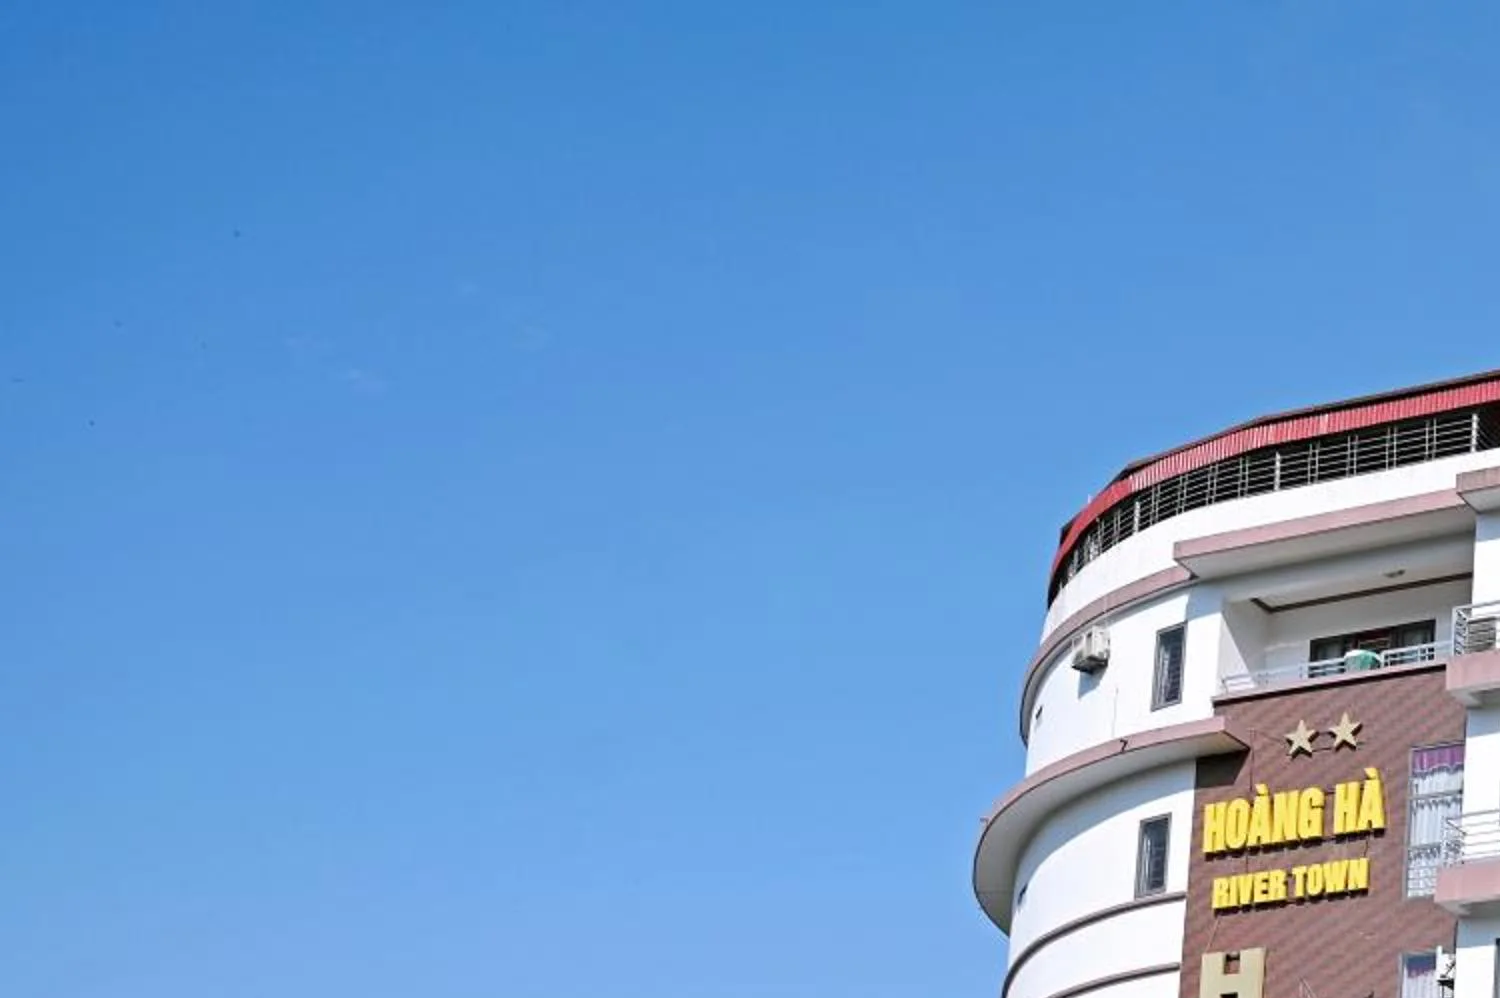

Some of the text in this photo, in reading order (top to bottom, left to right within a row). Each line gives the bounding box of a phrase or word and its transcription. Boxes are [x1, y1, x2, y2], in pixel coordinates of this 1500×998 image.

[1203, 767, 1385, 854] HOÀNG HÀ
[1212, 858, 1369, 909] RIVER TOWN
